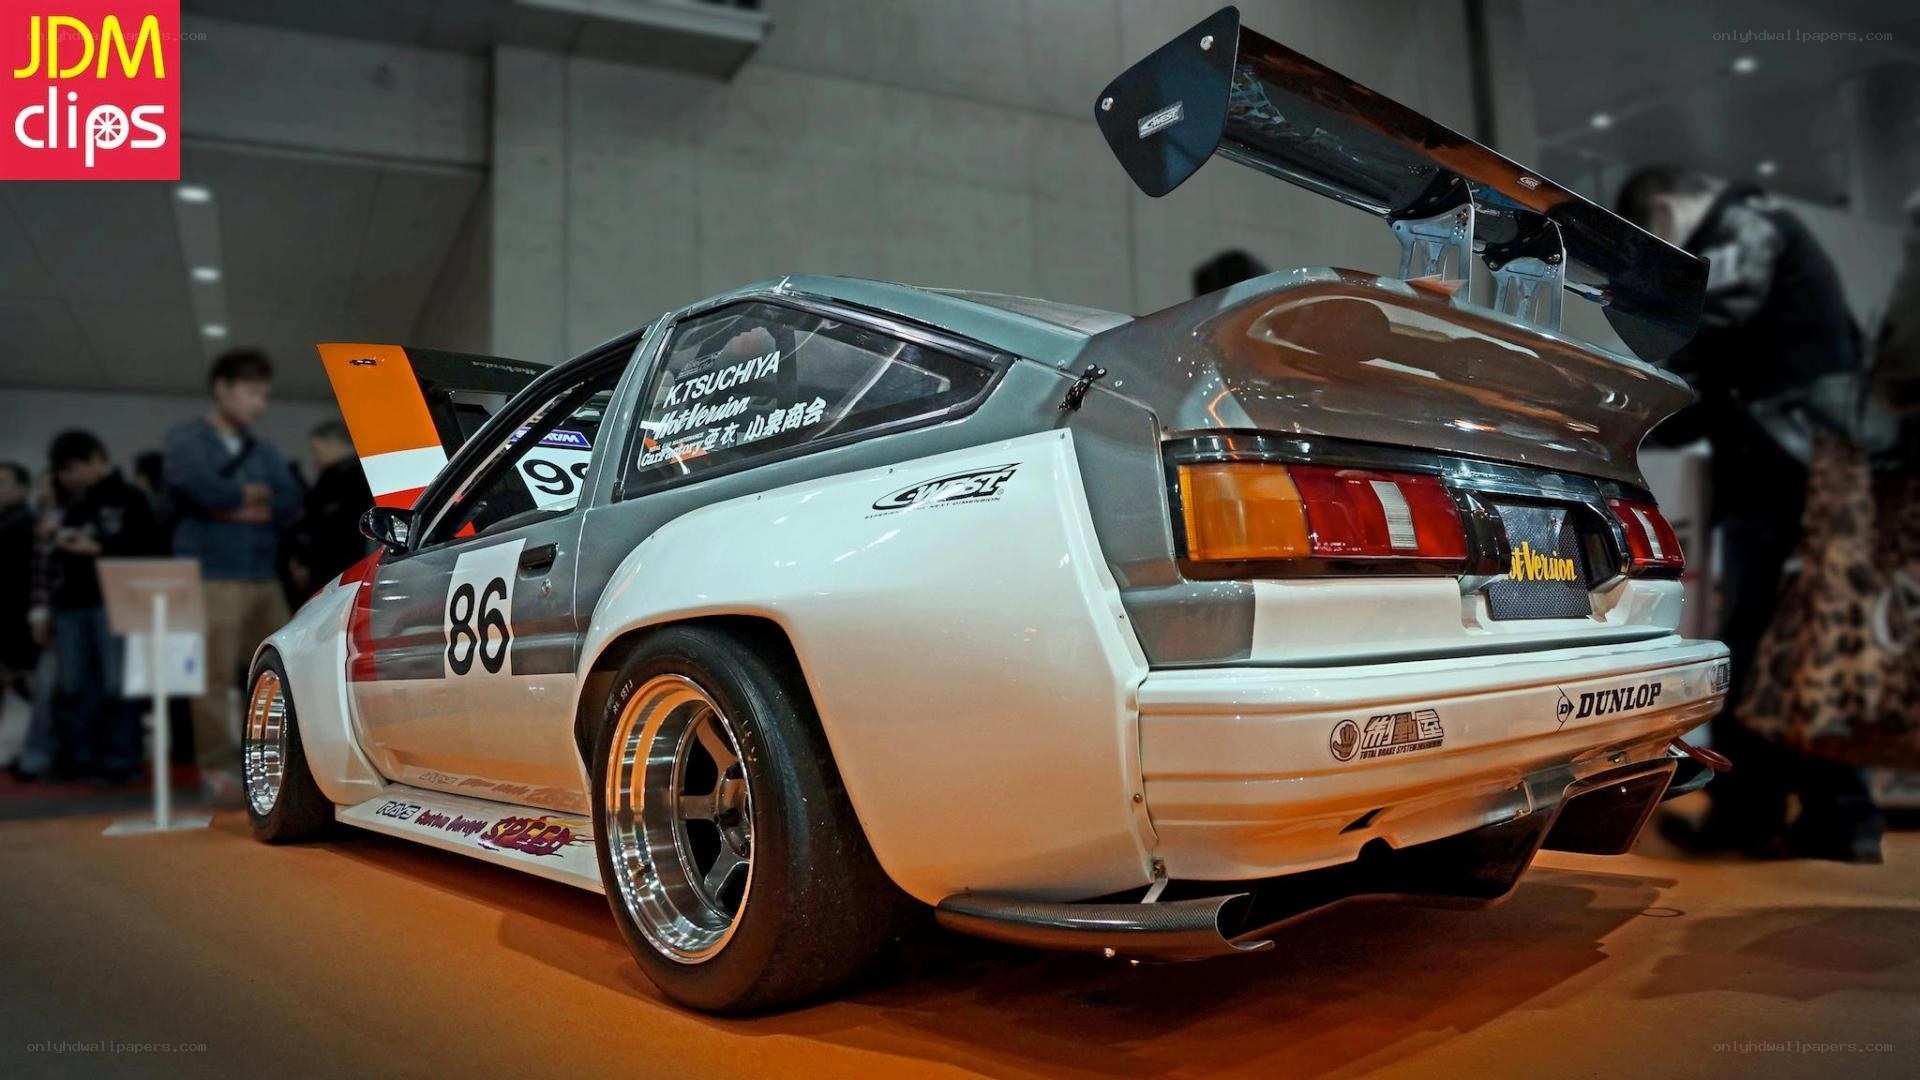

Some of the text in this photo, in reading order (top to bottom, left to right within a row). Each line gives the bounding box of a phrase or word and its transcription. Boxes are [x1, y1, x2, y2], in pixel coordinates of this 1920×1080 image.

[663, 350, 781, 408] K.TSUCHIYA
[448, 577, 510, 676] 86
[1575, 682, 1662, 719] DUNLOP
[376, 801, 421, 820] RAYS
